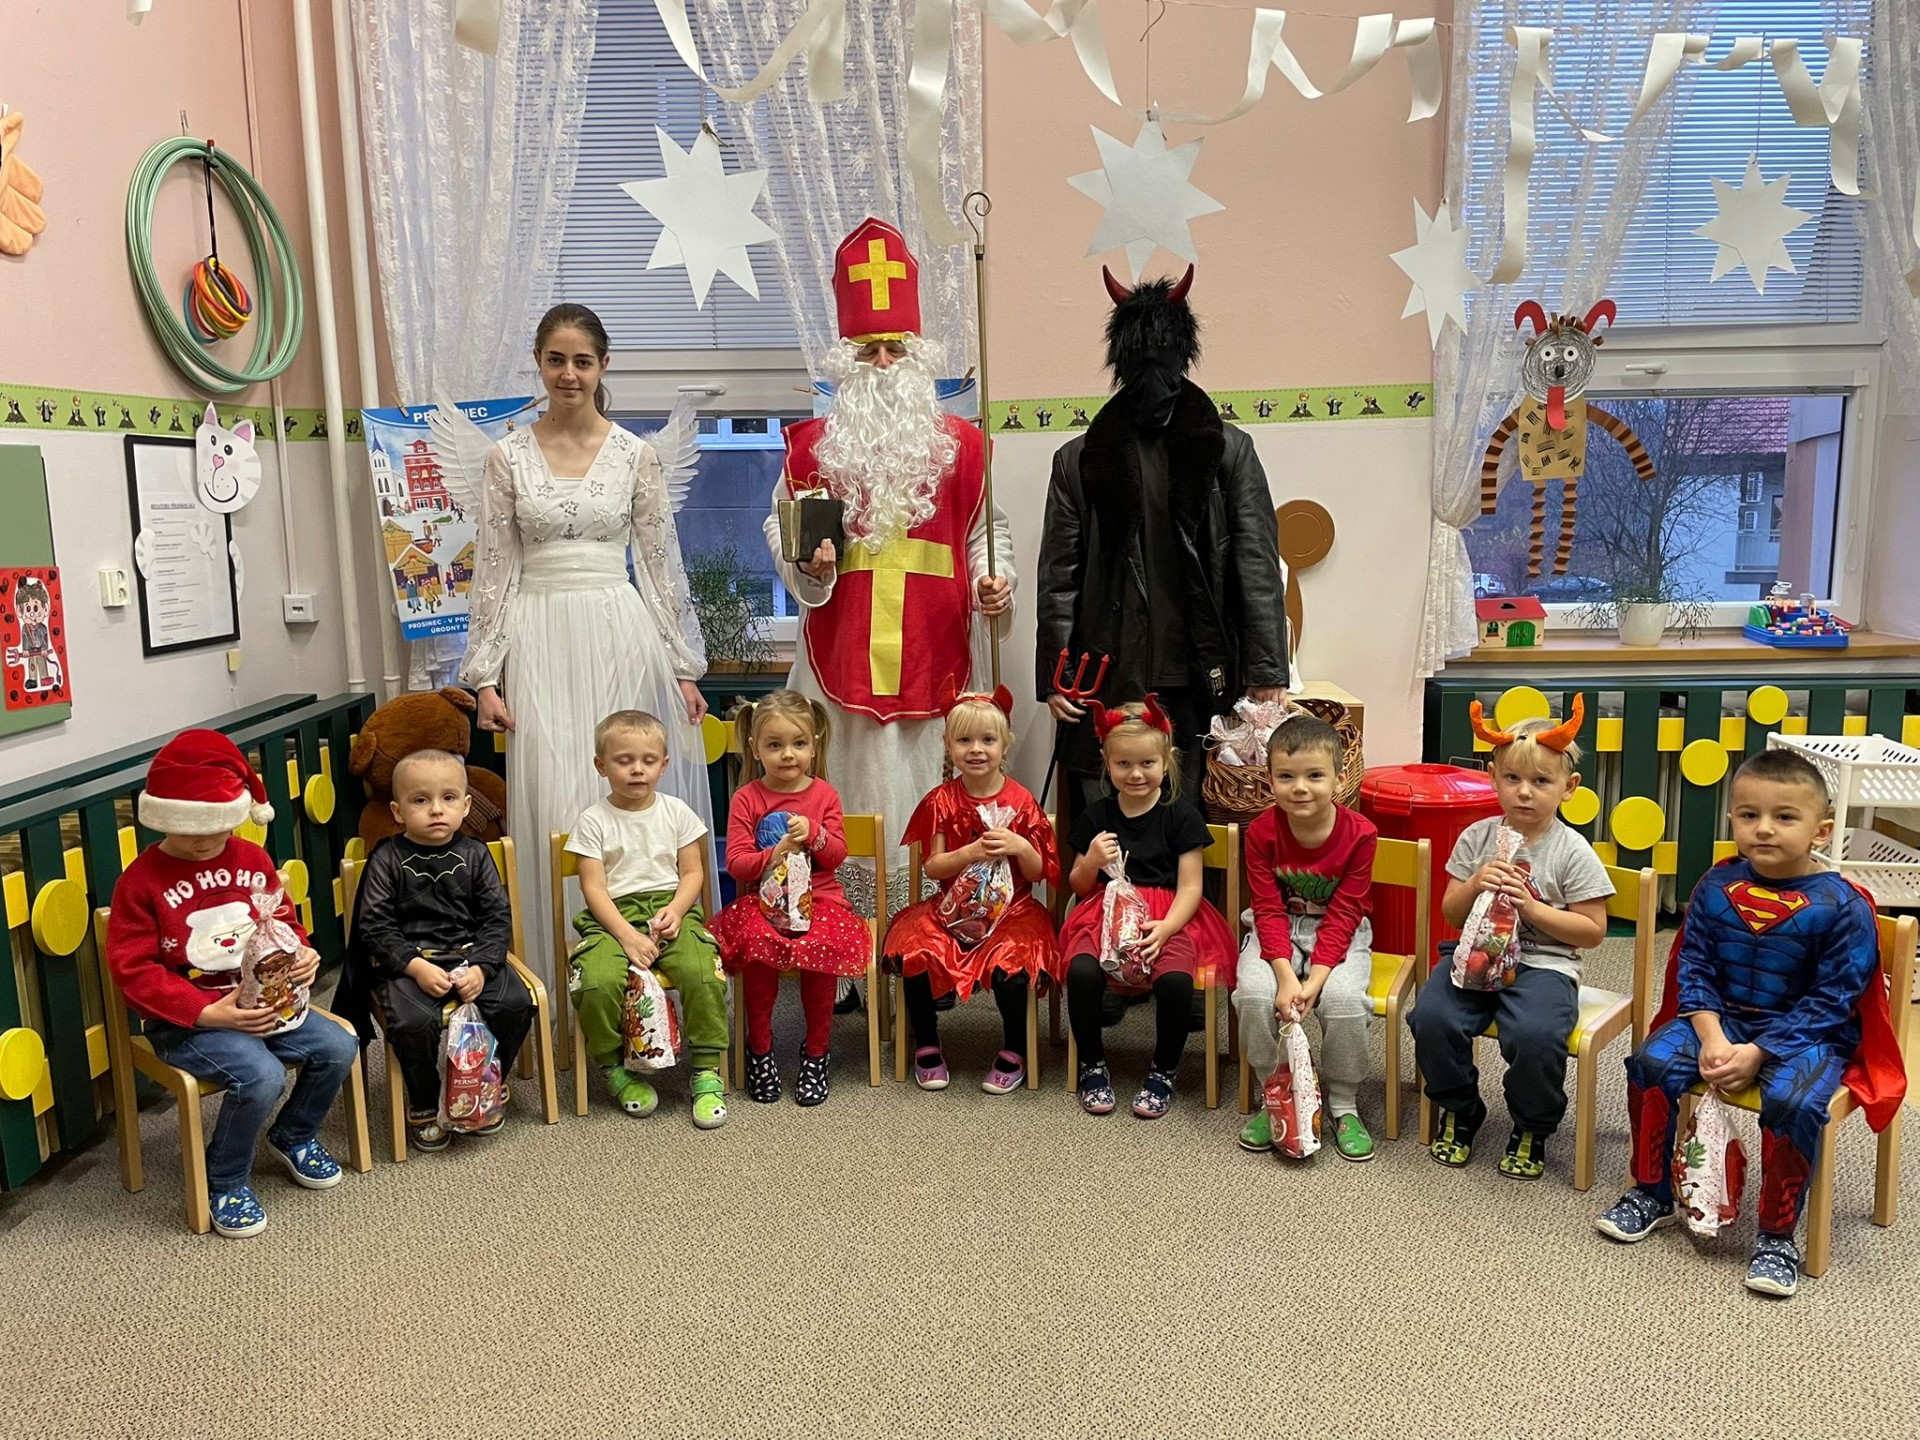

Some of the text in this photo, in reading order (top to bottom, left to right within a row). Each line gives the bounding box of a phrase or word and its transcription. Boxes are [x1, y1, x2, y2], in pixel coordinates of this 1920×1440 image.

[408, 619, 442, 630] PROSINEC
[163, 868, 267, 909] HO HO HO
